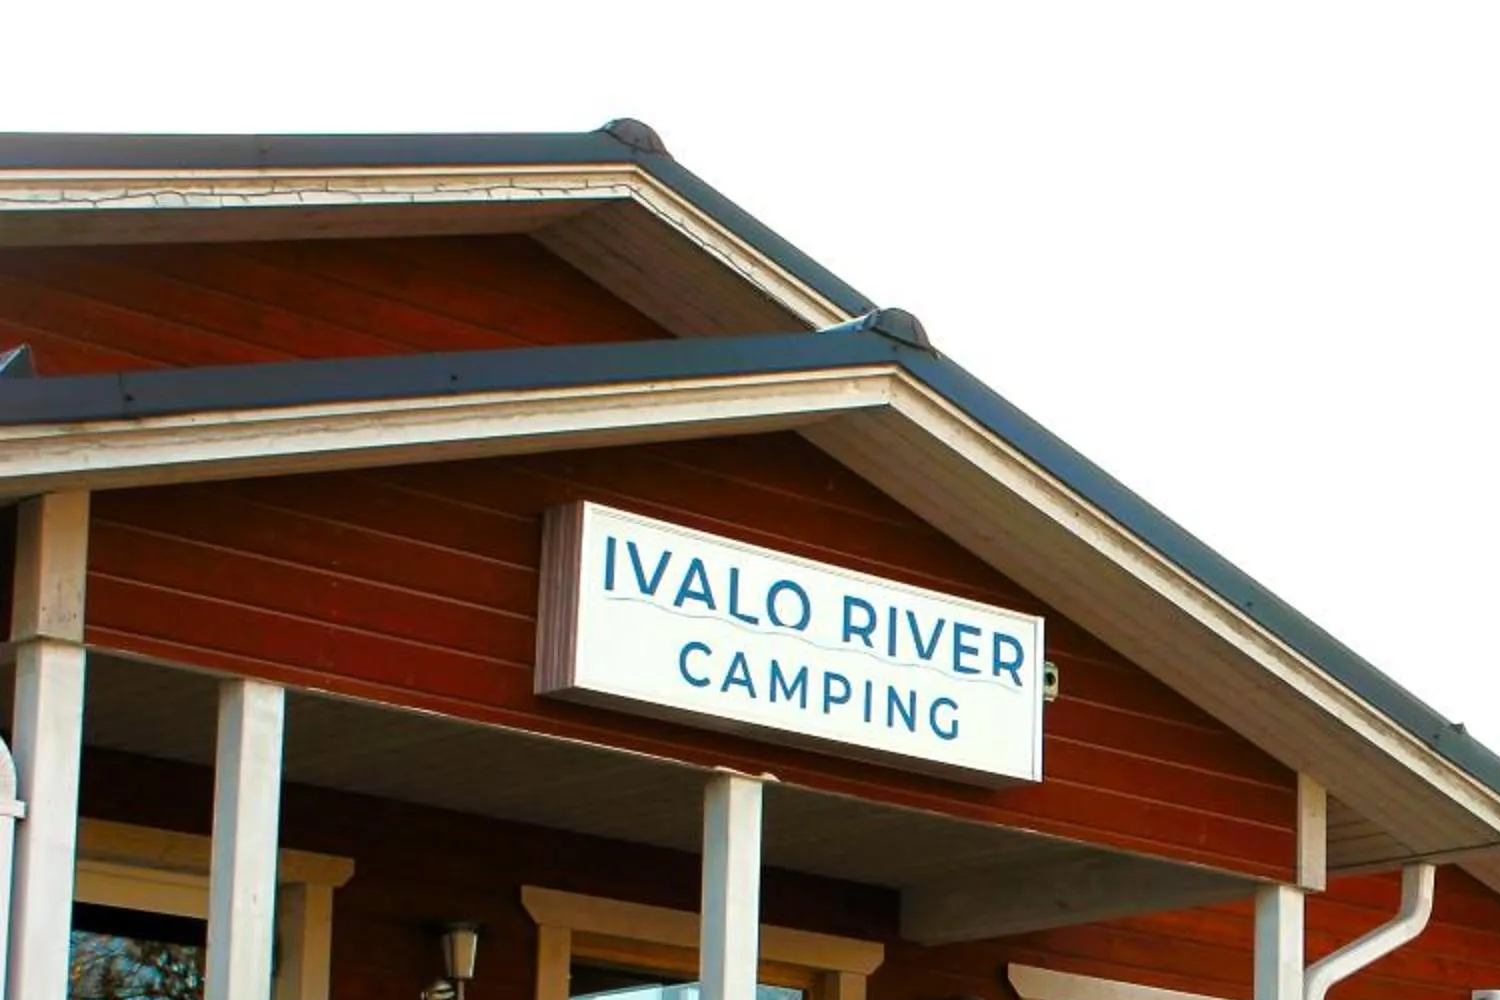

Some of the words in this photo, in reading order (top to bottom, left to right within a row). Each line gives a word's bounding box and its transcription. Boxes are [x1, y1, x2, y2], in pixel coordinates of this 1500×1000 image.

[603, 536, 812, 632] IVALO
[842, 595, 1025, 687] RIVER
[678, 640, 960, 741] CAMPING
